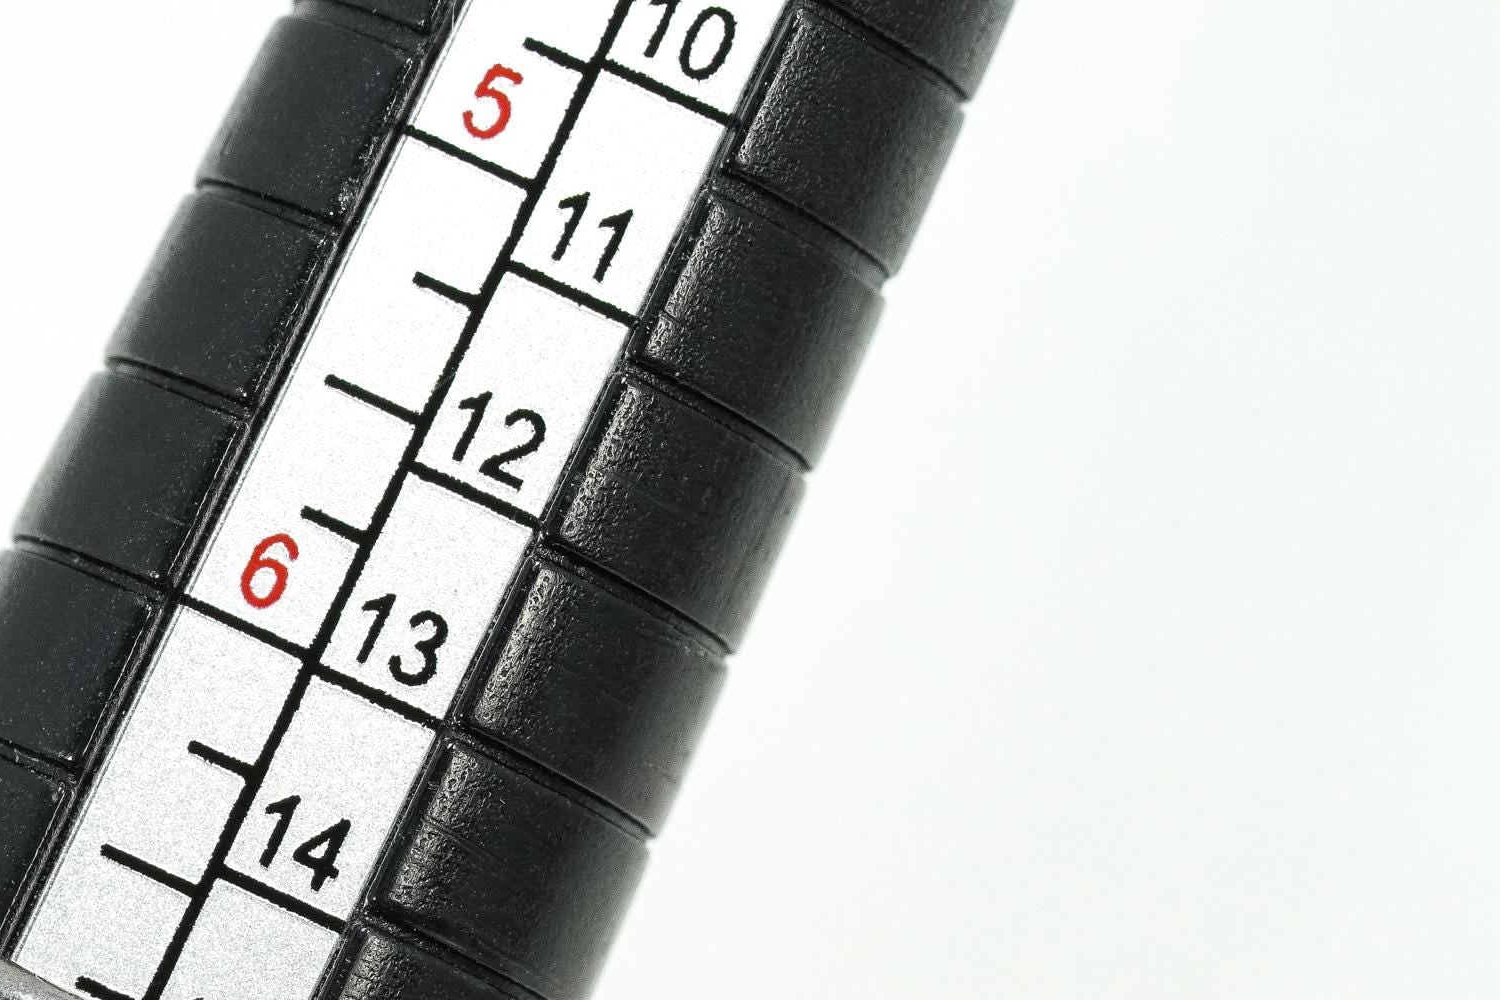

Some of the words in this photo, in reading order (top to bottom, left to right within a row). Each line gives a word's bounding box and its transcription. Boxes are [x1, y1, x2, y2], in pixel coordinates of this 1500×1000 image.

[643, 0, 738, 82] 10
[463, 63, 523, 140] 5
[551, 191, 634, 283] 11
[452, 391, 547, 492] 12
[240, 533, 299, 609] 6
[356, 593, 449, 687] 13
[258, 794, 352, 893] 14
